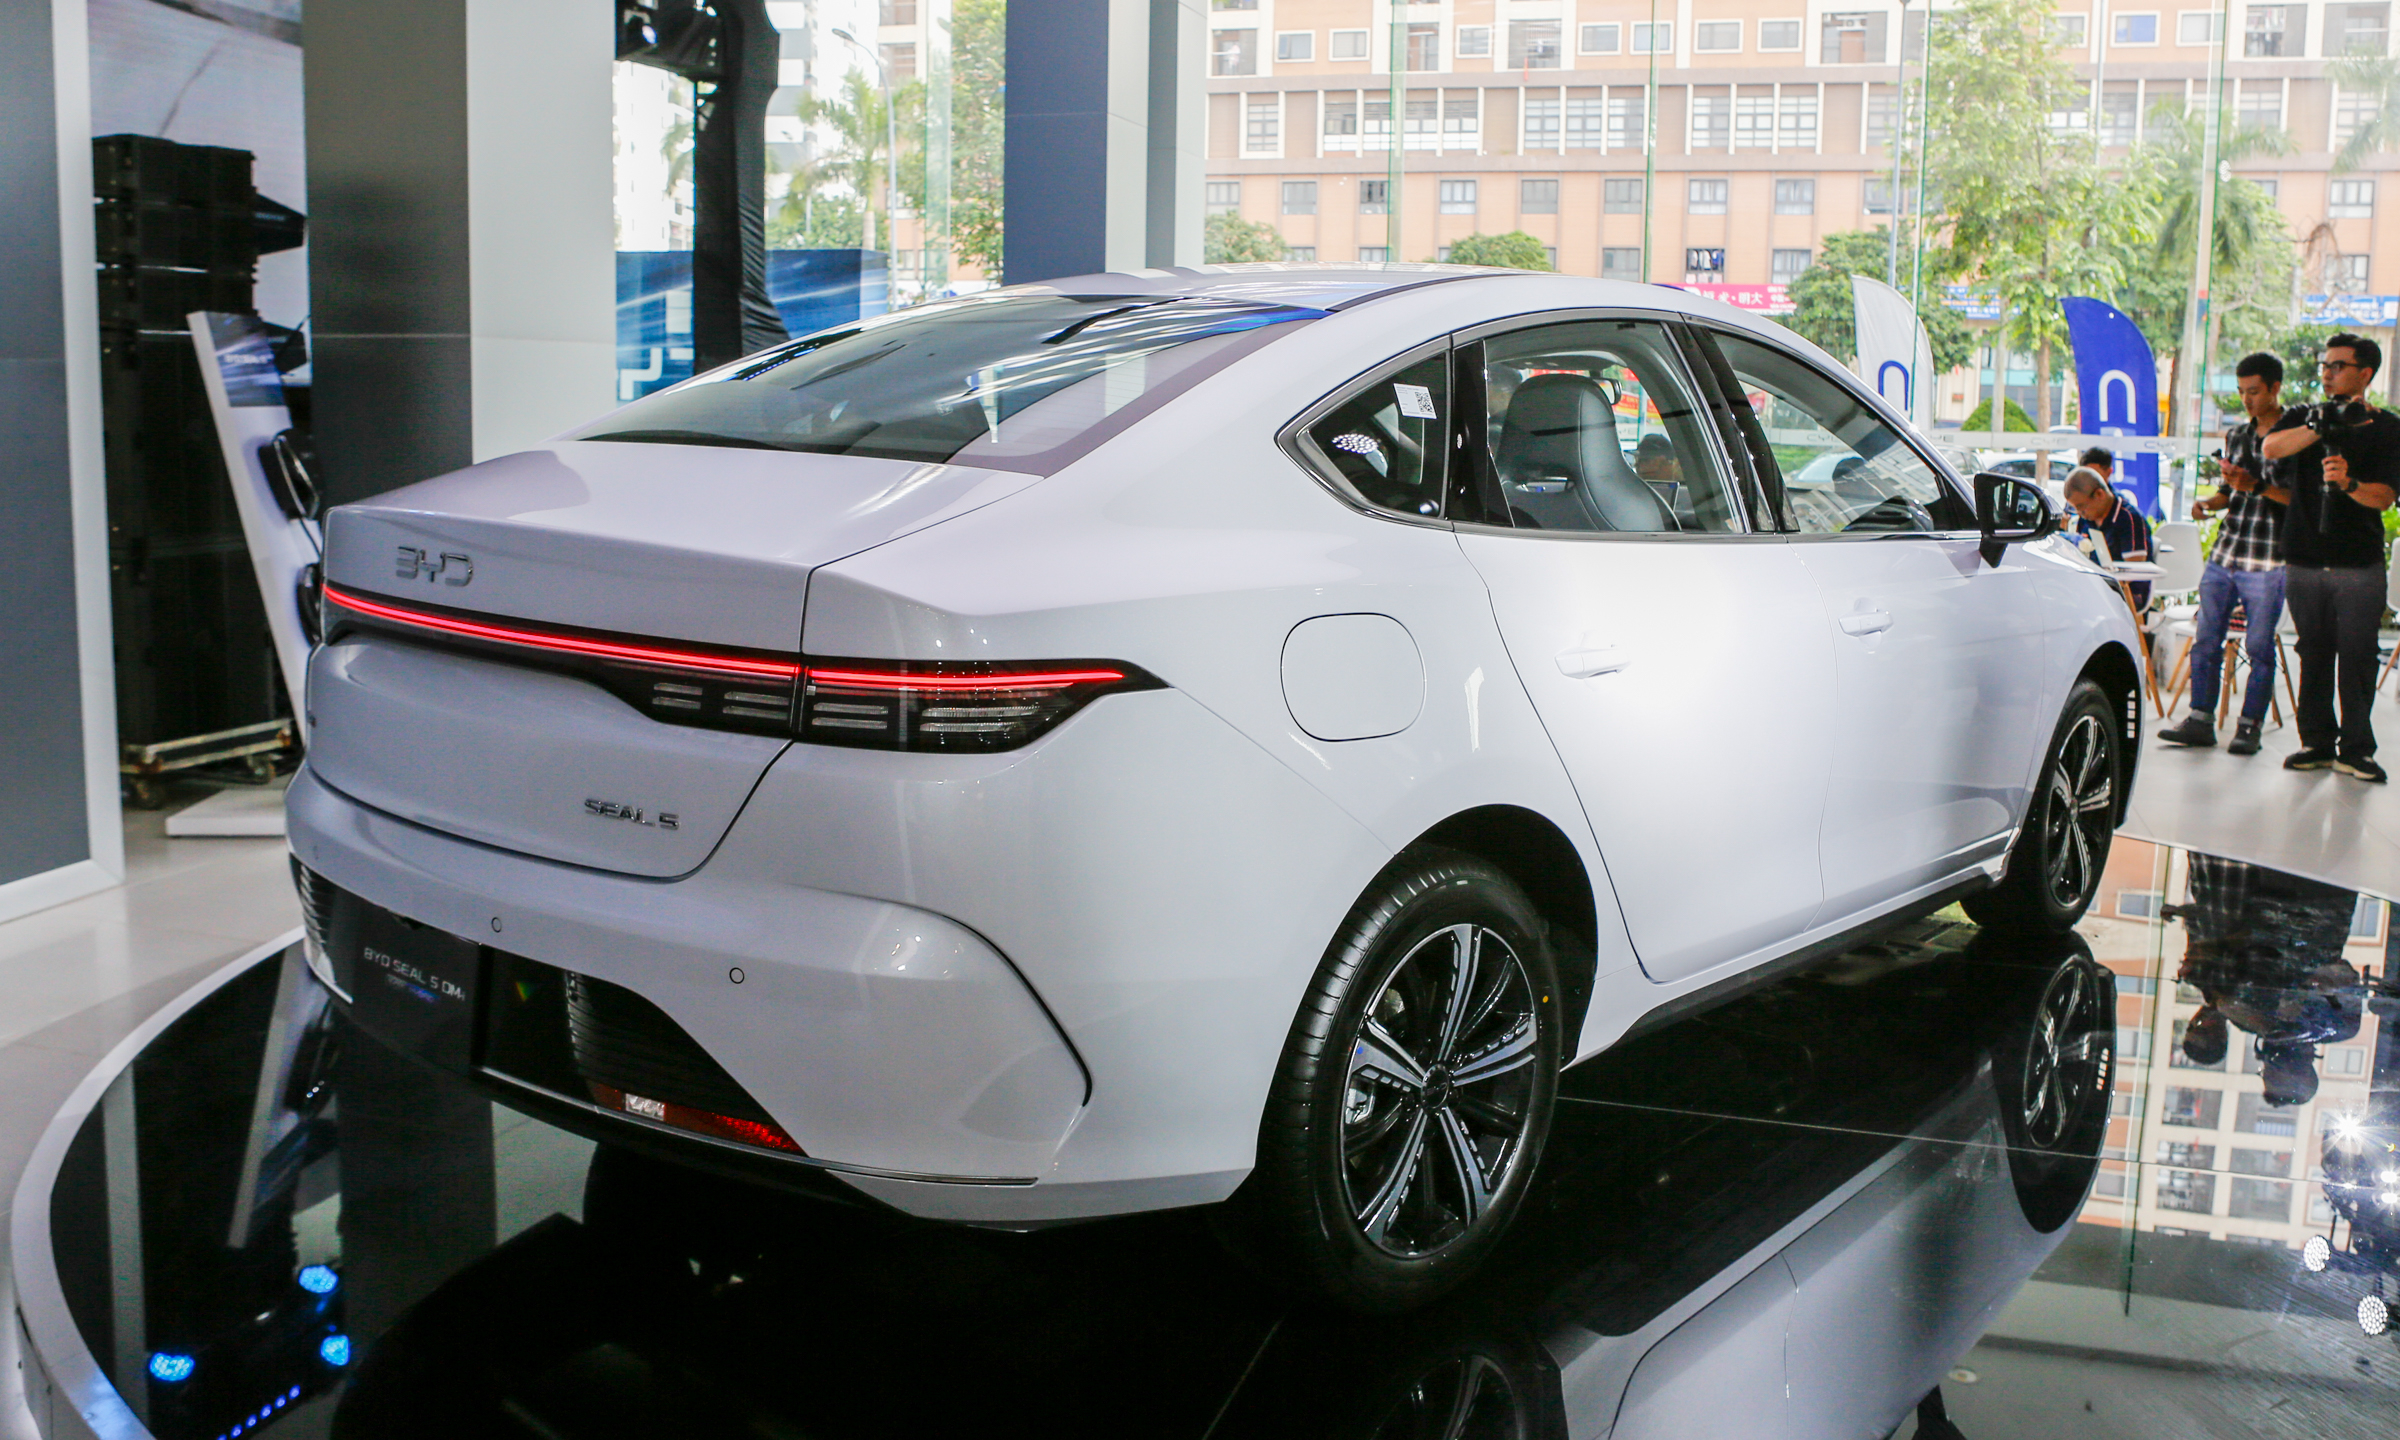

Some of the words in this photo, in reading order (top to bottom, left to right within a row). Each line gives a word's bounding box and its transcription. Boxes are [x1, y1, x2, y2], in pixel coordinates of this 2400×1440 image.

[396, 546, 474, 587] BYD
[584, 798, 656, 828] SEAL
[659, 811, 681, 831] 5
[364, 948, 390, 967] BYD
[393, 960, 426, 984] SEAL
[430, 976, 438, 989] 5
